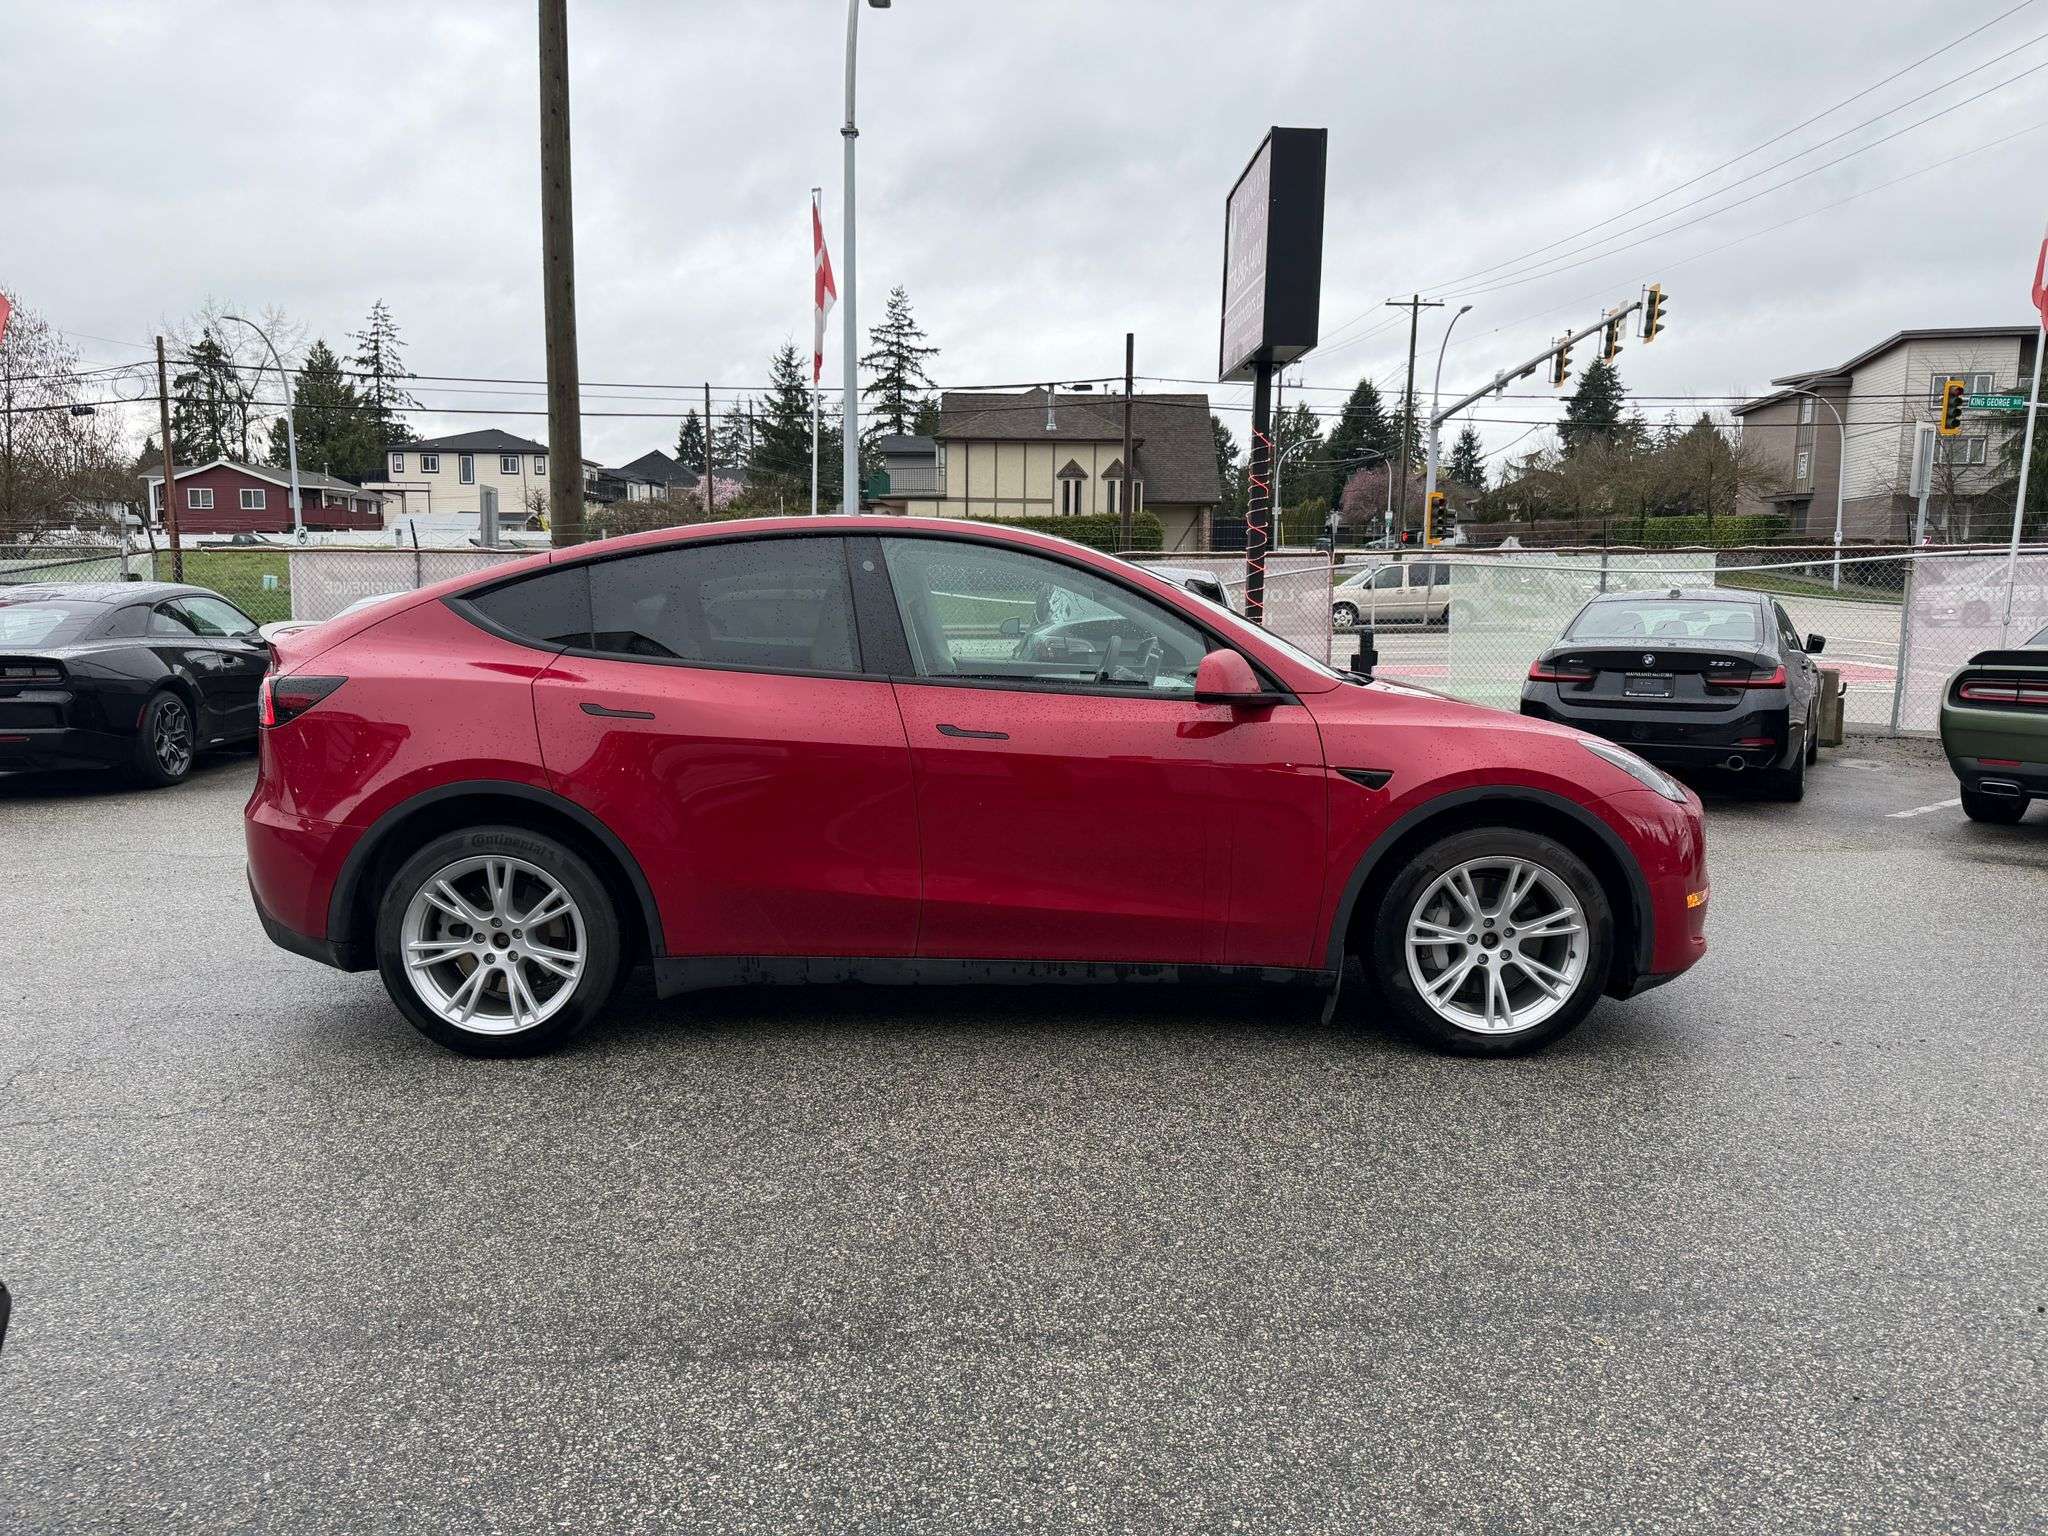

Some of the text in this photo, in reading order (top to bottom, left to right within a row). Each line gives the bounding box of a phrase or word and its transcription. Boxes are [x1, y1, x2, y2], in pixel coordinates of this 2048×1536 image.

[1970, 397, 1985, 406] KING
[1986, 398, 2011, 407] GEORGE
[472, 834, 546, 856] Continental
